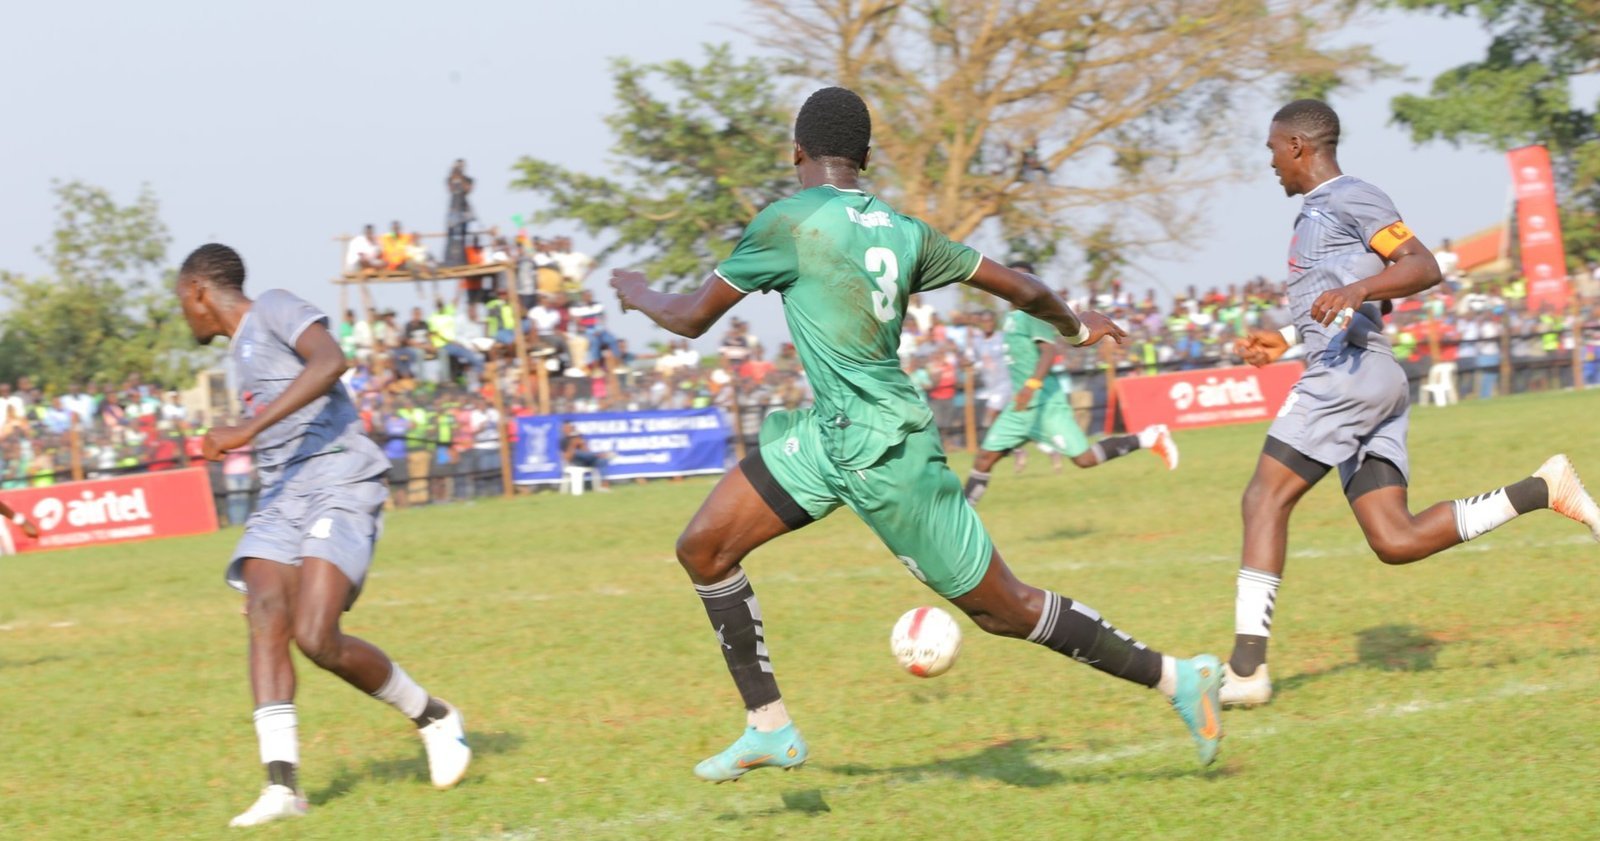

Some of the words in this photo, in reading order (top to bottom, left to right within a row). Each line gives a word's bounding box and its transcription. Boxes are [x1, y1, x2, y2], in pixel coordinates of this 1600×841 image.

[1388, 224, 1408, 240] C
[865, 246, 899, 323] 3
[1197, 375, 1265, 408] airtel
[67, 487, 152, 528] airtel
